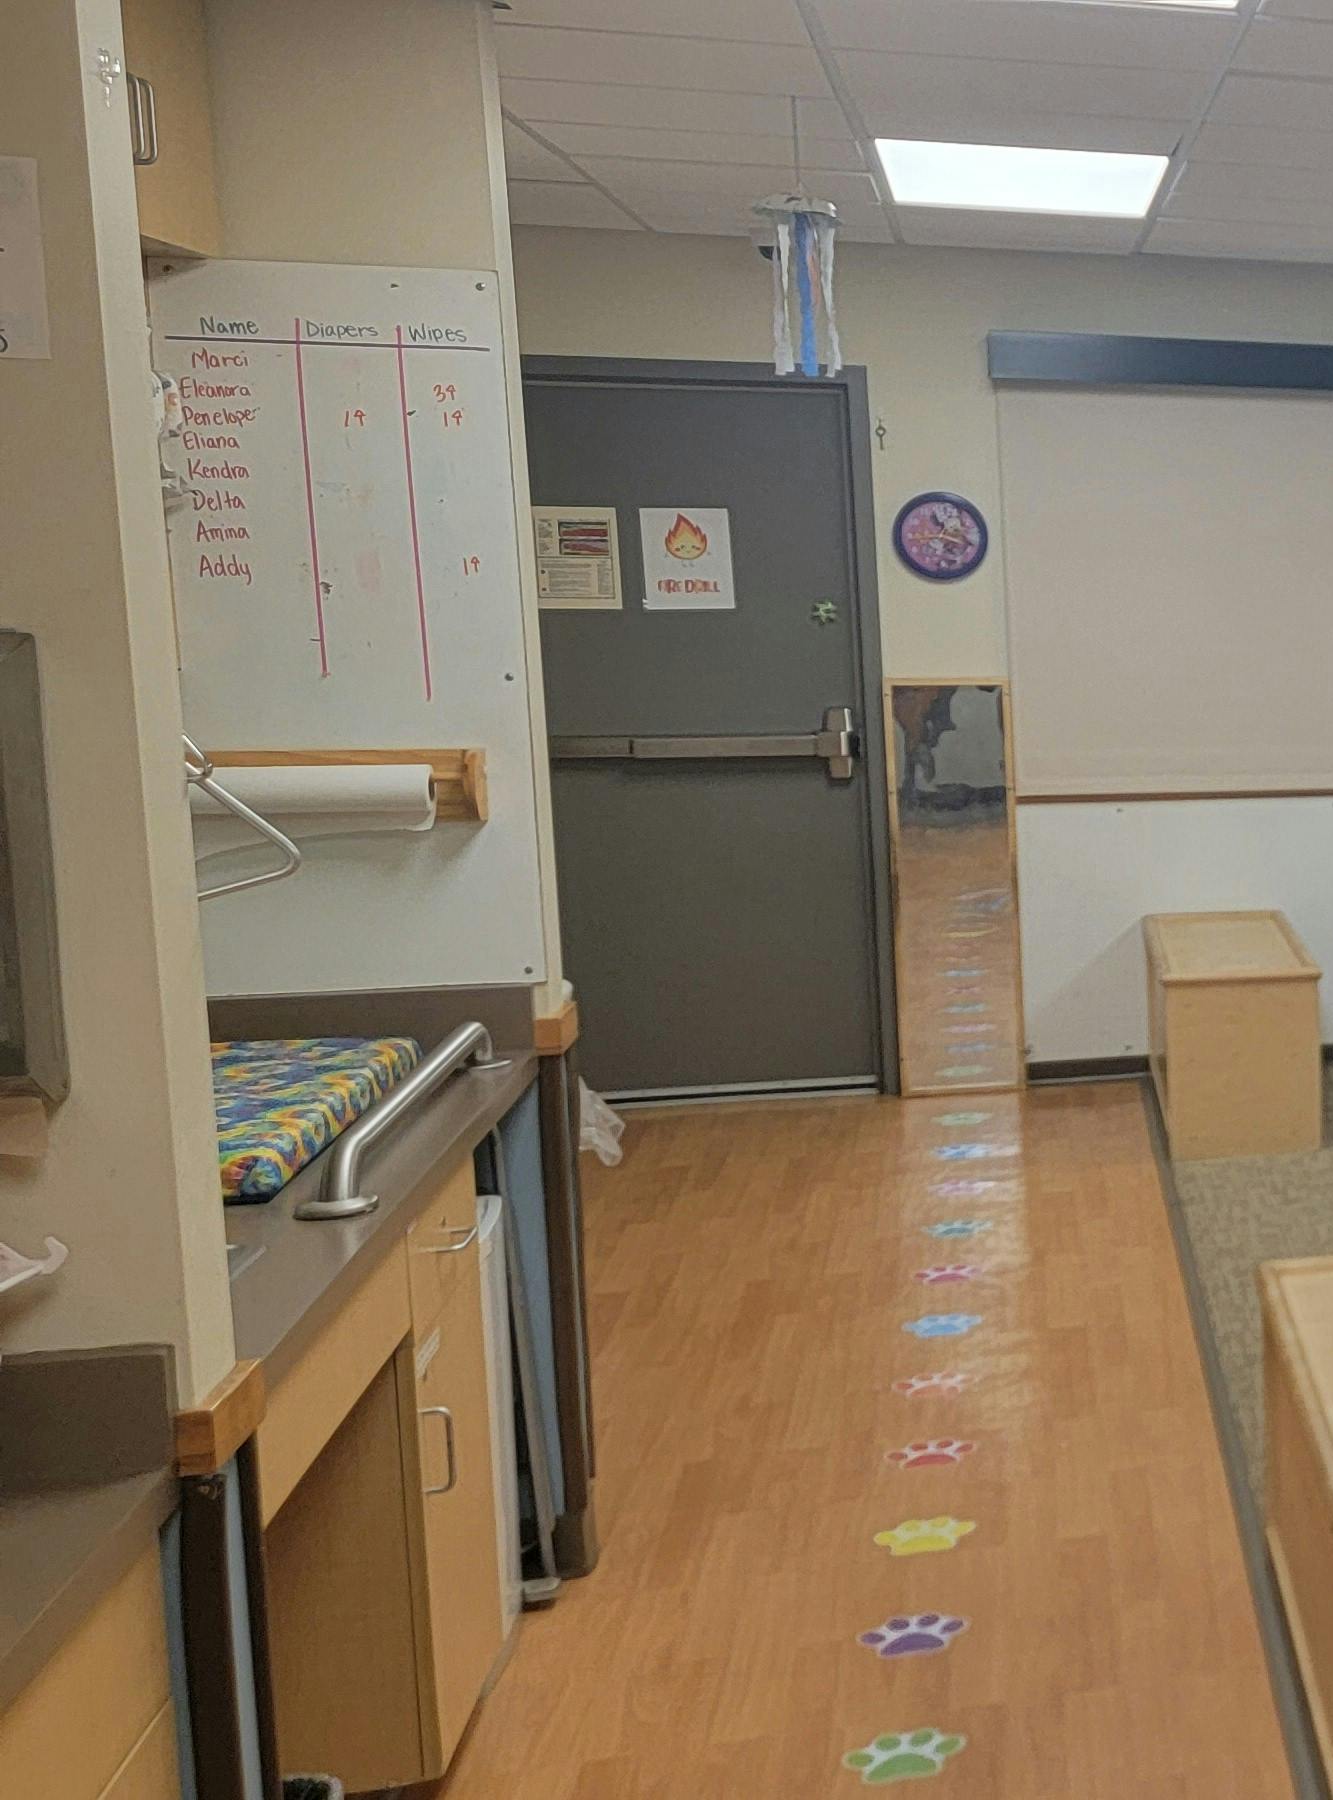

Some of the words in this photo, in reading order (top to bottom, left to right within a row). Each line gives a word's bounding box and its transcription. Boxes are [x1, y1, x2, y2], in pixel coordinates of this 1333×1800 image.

[200, 316, 259, 335] Name
[306, 320, 378, 339] Diapers
[409, 323, 467, 343] Wipes
[192, 347, 249, 369] Marci
[180, 376, 251, 399] Eleanora
[182, 405, 256, 428] Penelope
[183, 431, 240, 450] Eliana
[188, 458, 249, 480] Kendra
[192, 489, 245, 511] Delta
[197, 519, 250, 542] Amina
[200, 554, 252, 585] Addy
